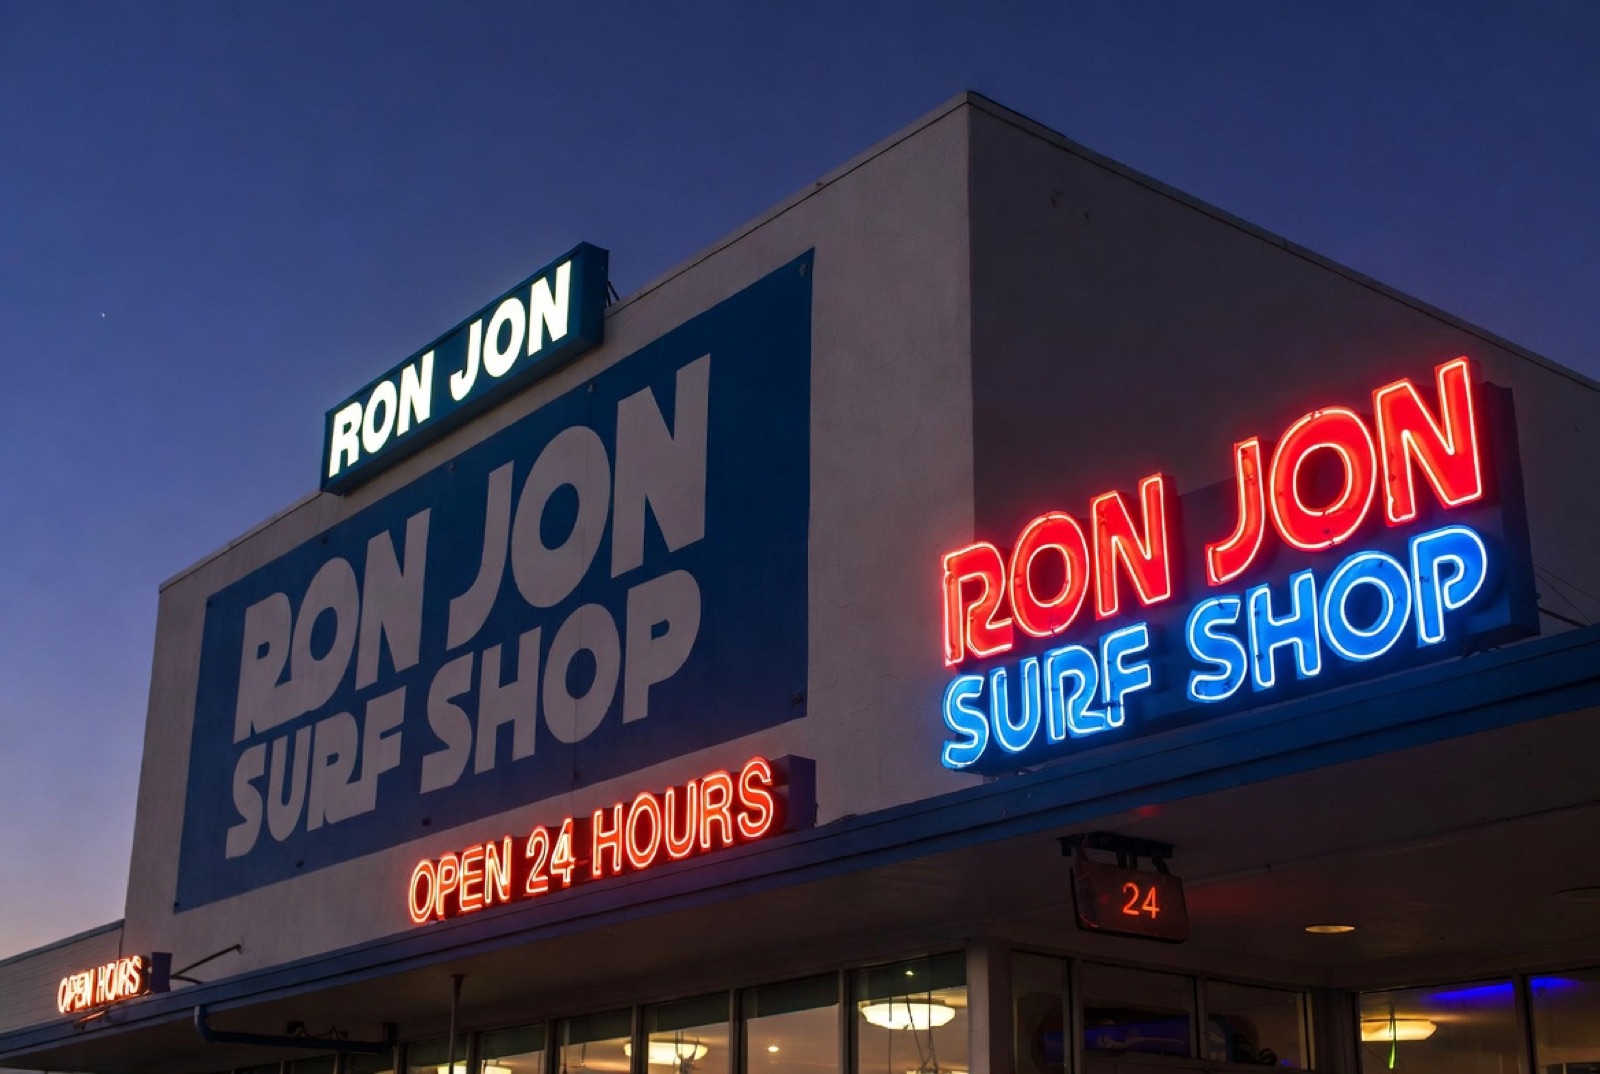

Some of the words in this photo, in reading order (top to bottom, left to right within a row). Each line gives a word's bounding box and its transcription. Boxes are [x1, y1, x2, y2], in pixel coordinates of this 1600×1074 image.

[329, 352, 434, 478] RON
[450, 261, 571, 401] JON
[234, 507, 431, 744] RON
[446, 353, 710, 651] JON
[941, 472, 1170, 666] RON
[1207, 356, 1482, 585] JON
[226, 686, 406, 859] SURF
[420, 570, 701, 793] SHOP
[941, 623, 1152, 770] SURF
[1188, 525, 1487, 702] SHOP
[409, 834, 512, 924] OPEN
[525, 818, 576, 896] 24
[592, 756, 775, 878] HOURS
[1122, 882, 1160, 919] 24
[58, 968, 94, 1014] OPEN
